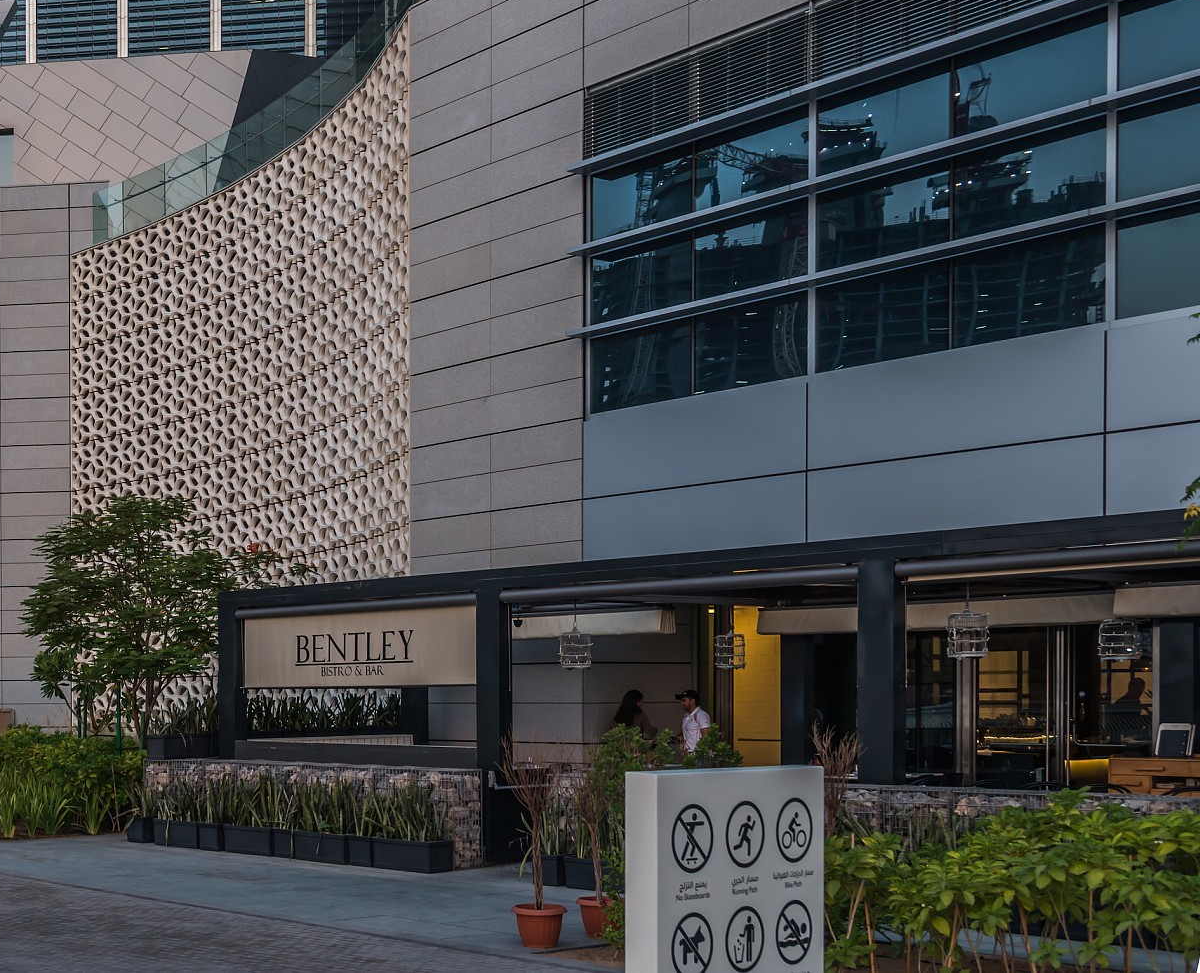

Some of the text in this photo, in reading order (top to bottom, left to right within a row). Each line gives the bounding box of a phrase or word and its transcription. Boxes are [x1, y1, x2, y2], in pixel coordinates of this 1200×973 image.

[295, 629, 415, 664] BENTLEY
[320, 665, 385, 677] BISTRO & BAR
[675, 894, 683, 902] No
